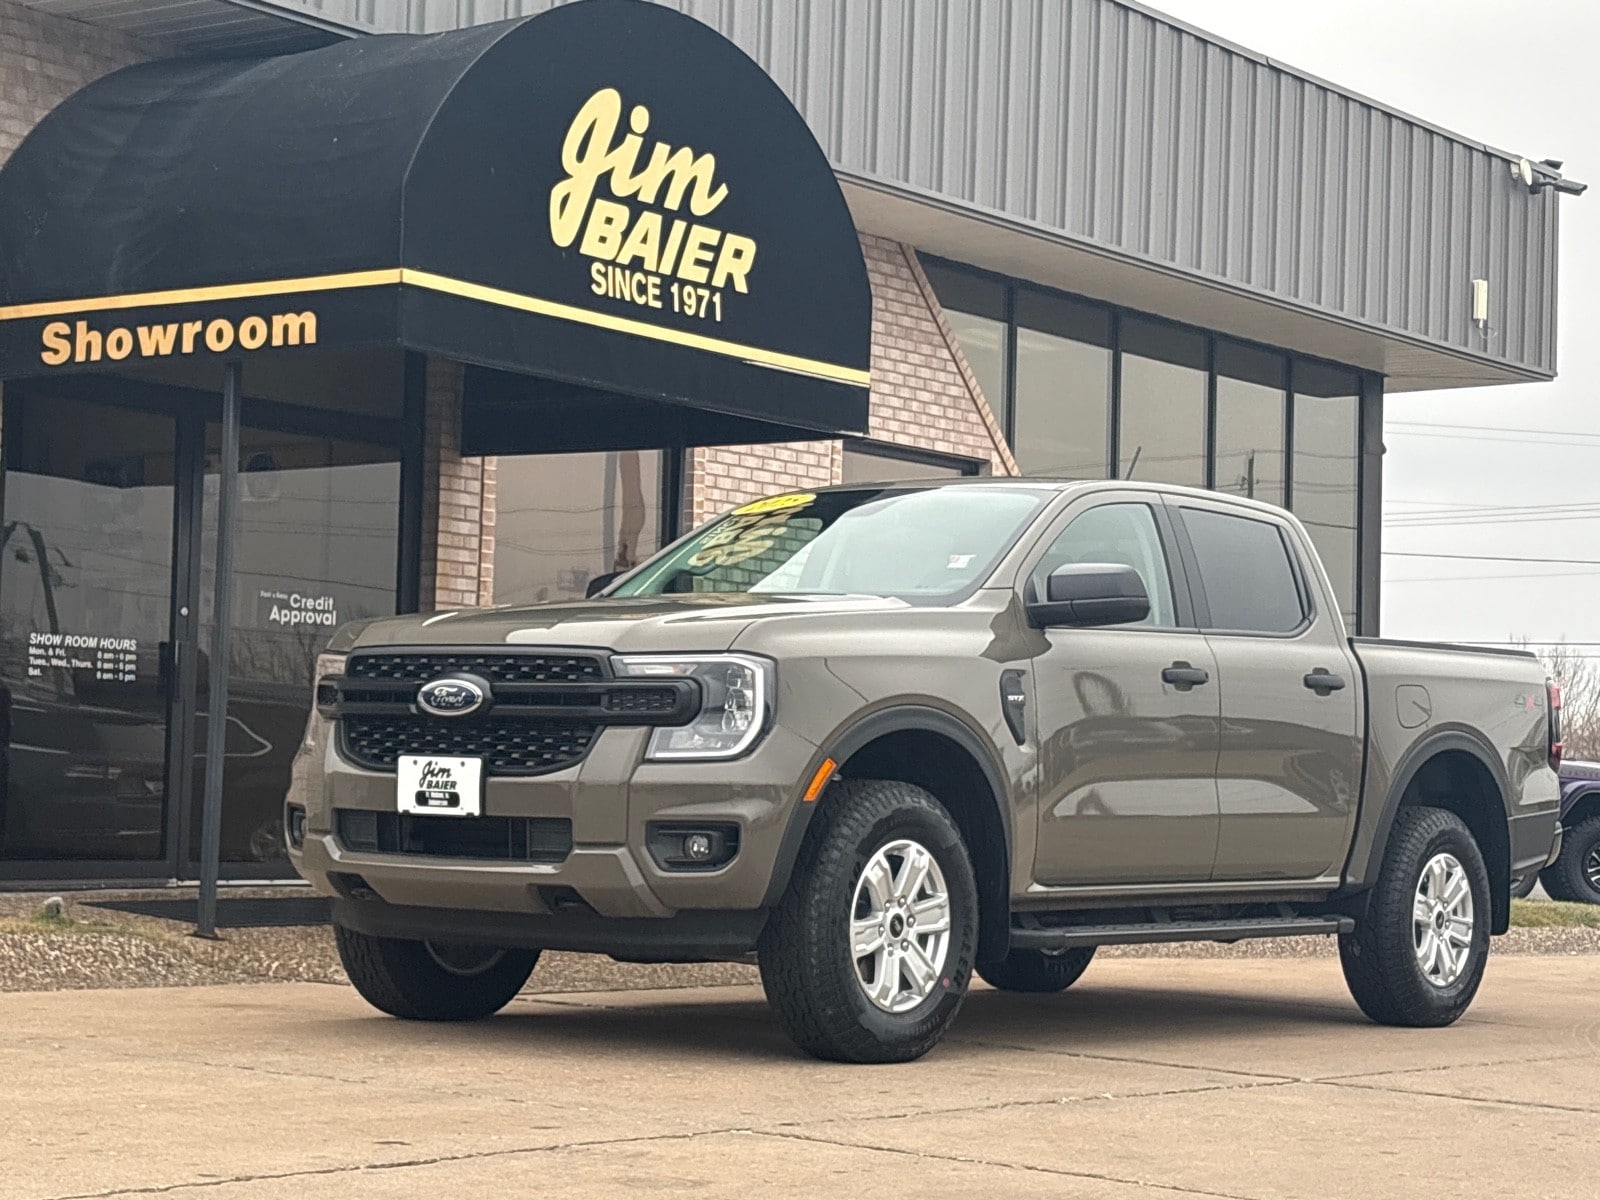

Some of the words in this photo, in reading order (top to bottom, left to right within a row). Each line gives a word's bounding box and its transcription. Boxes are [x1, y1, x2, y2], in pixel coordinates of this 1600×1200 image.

[550, 88, 729, 247] Jim
[579, 198, 757, 294] BAIER
[591, 262, 662, 309] SINCE
[670, 282, 721, 322] 1971
[41, 310, 317, 366] Showroom
[290, 594, 334, 611] Credit
[269, 605, 337, 626] Approval
[30, 632, 63, 646] SHOW
[64, 635, 98, 649] ROOM
[100, 637, 137, 651] HOURS
[431, 687, 466, 706] Ford
[419, 760, 452, 788] Jim
[426, 780, 458, 790] BAIER
